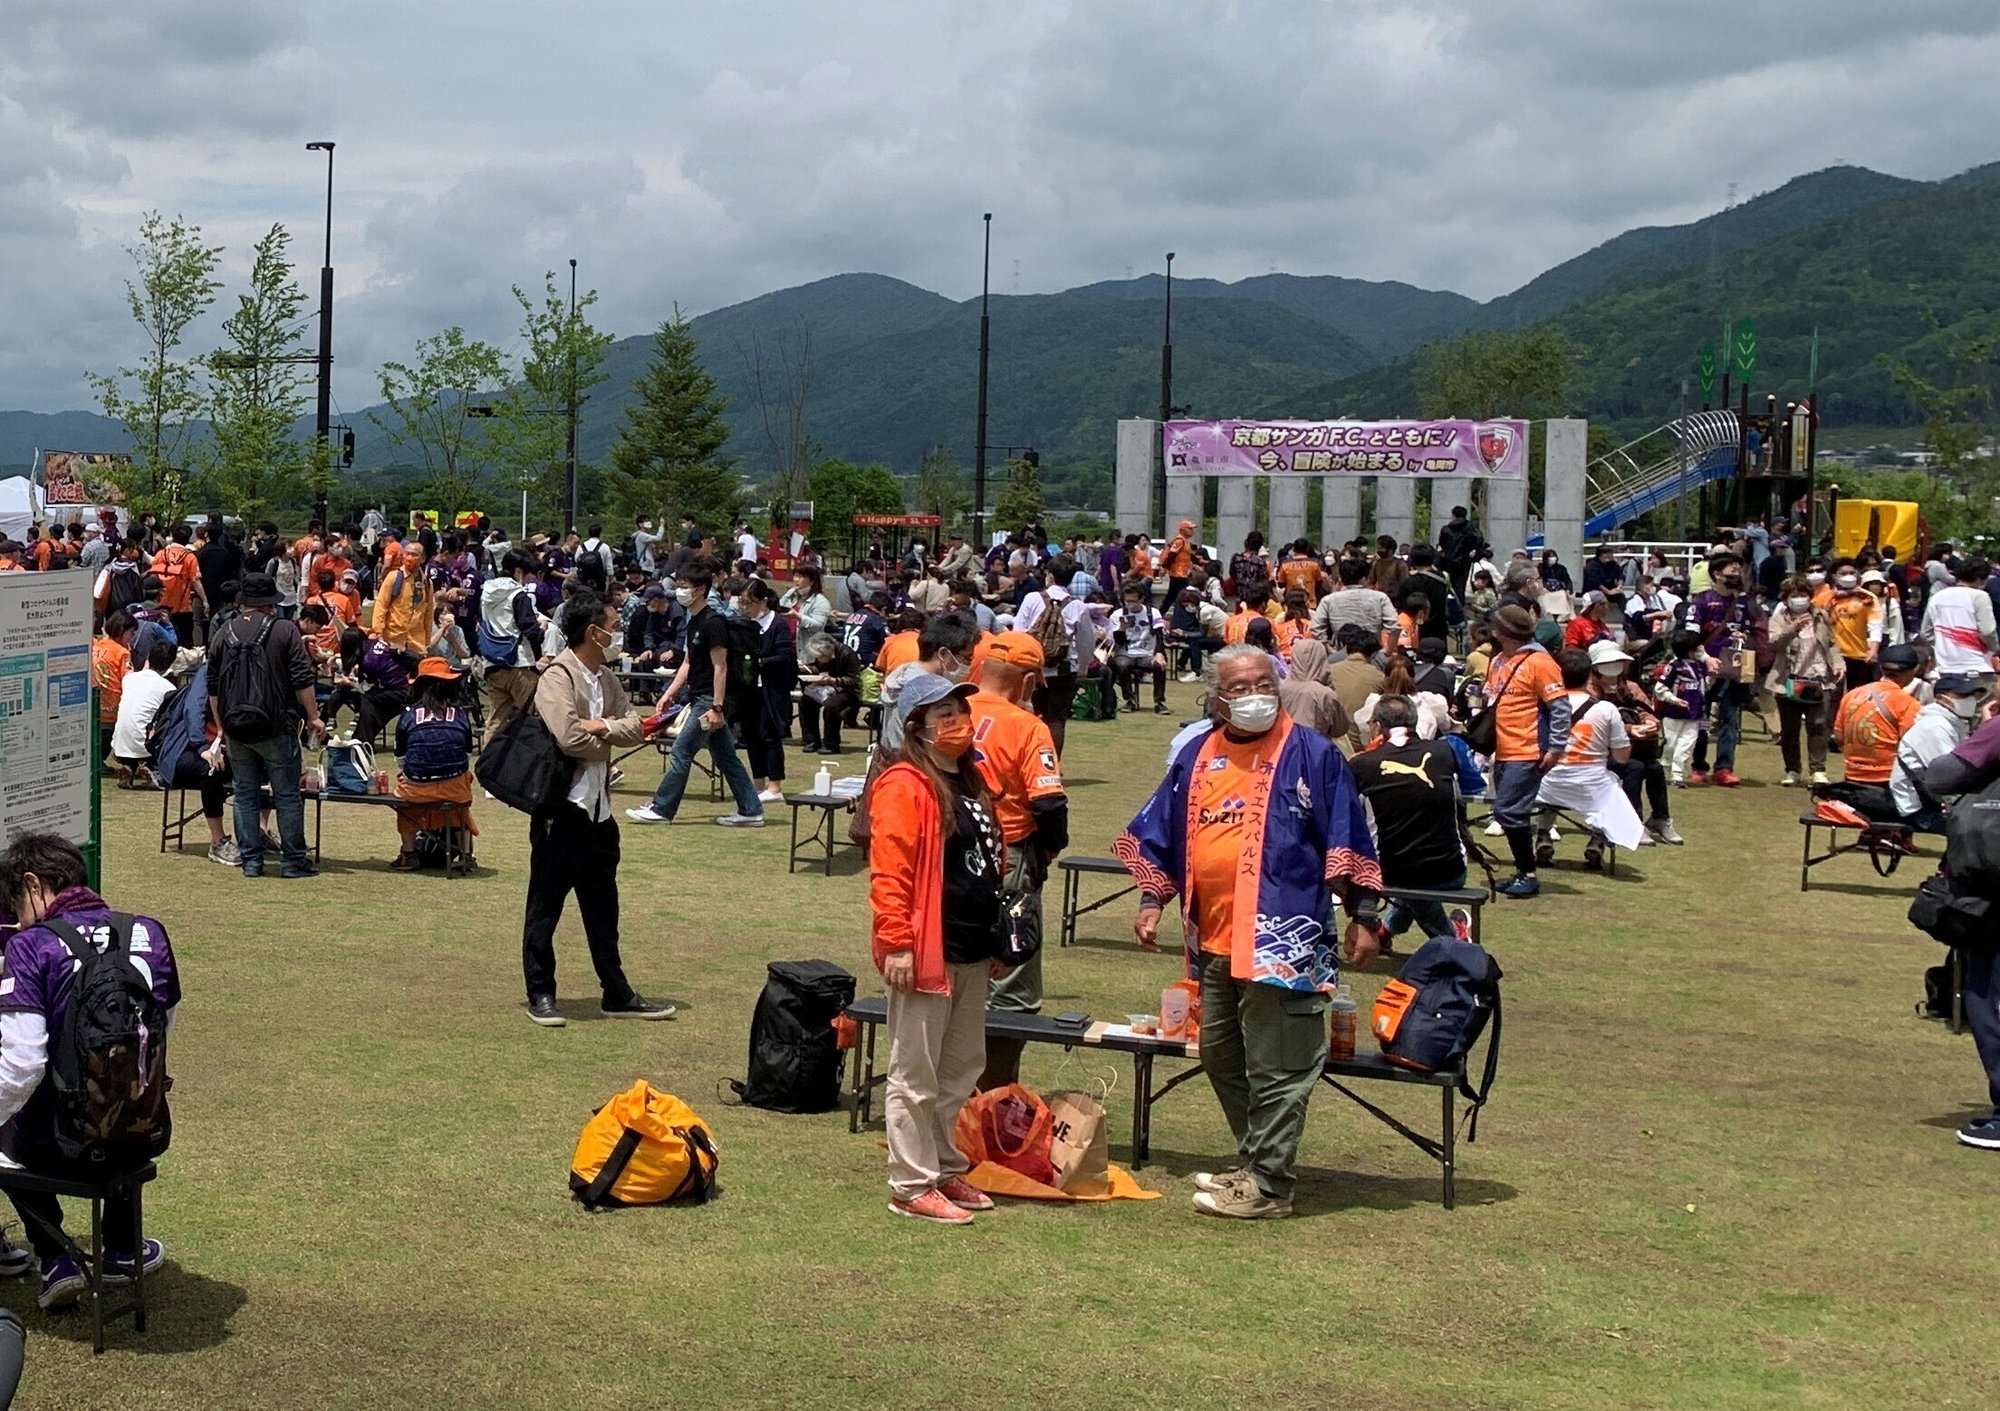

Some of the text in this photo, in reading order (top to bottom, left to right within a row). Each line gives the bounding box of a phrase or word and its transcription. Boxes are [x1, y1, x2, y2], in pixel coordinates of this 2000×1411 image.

[1259, 450, 1457, 473] 今、冒険が始まる by 亀岡市
[843, 625, 862, 652] 16
